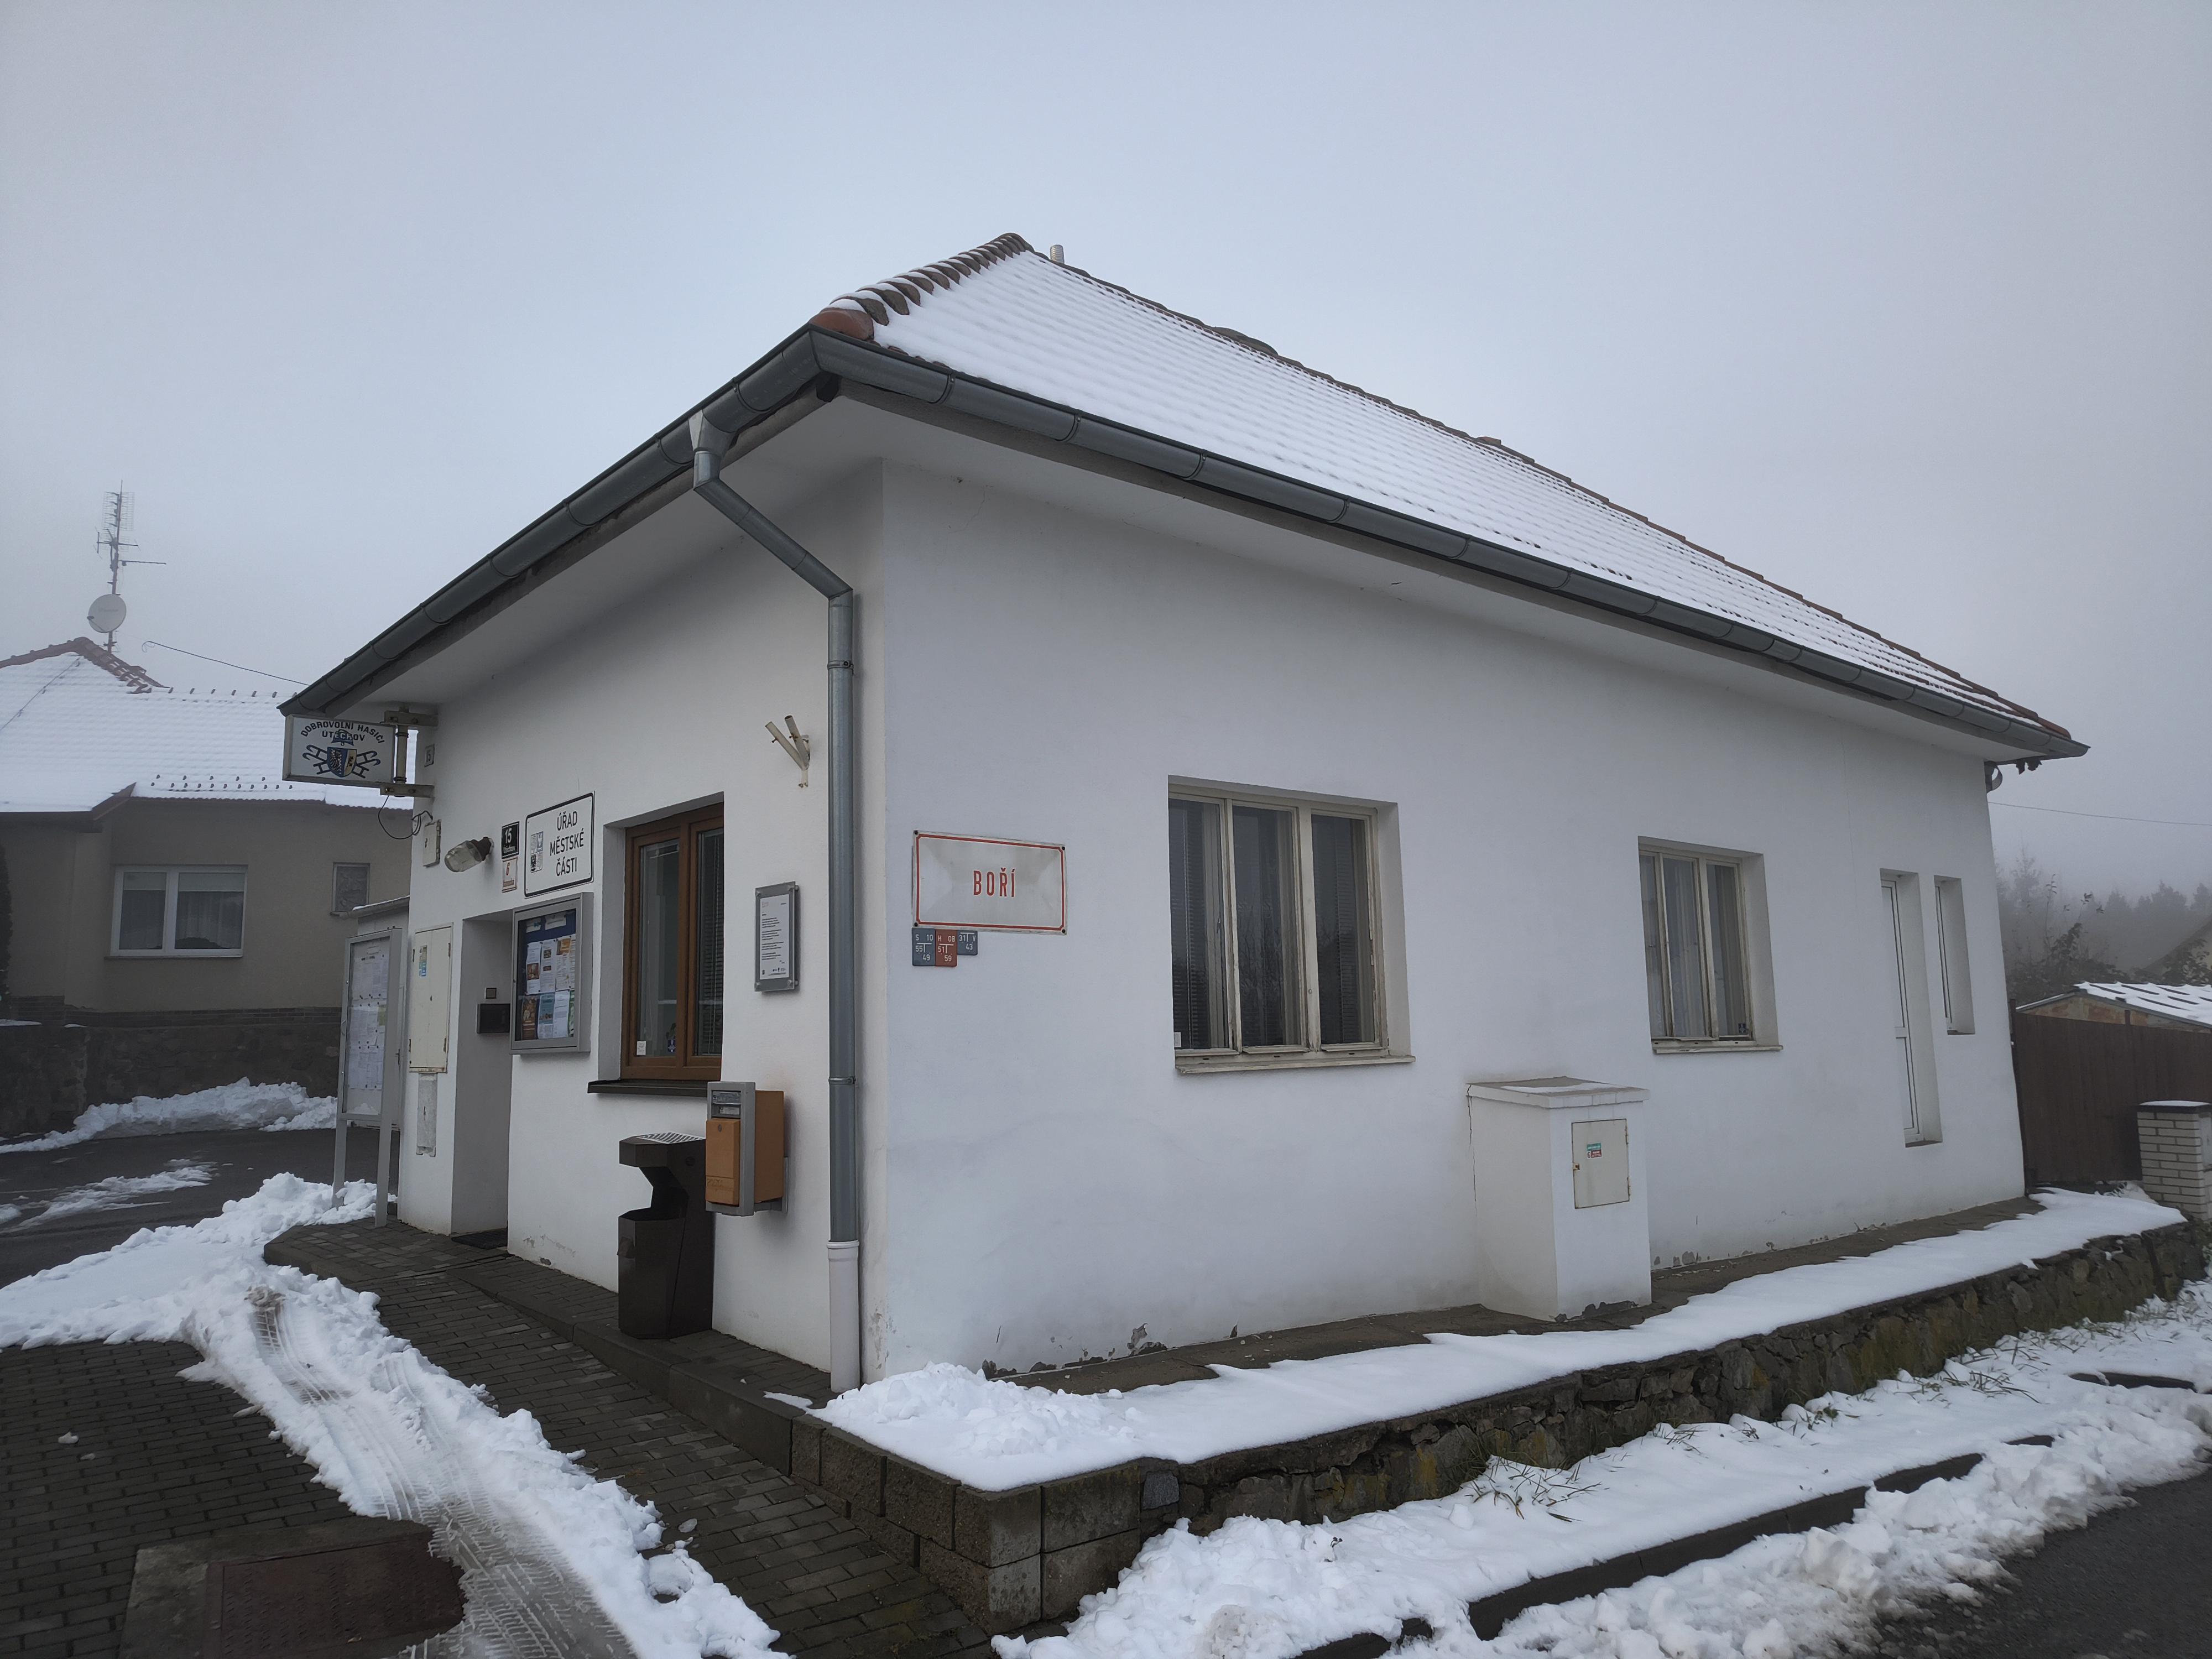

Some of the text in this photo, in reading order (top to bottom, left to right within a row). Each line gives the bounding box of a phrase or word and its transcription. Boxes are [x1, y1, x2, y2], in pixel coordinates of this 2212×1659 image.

[557, 811, 578, 831] ÚŘAD
[505, 828, 512, 844] 15
[550, 828, 585, 857] MĚSTSKÉ
[556, 856, 577, 877] ČÁSTI
[973, 867, 1015, 898] BOŘÍ
